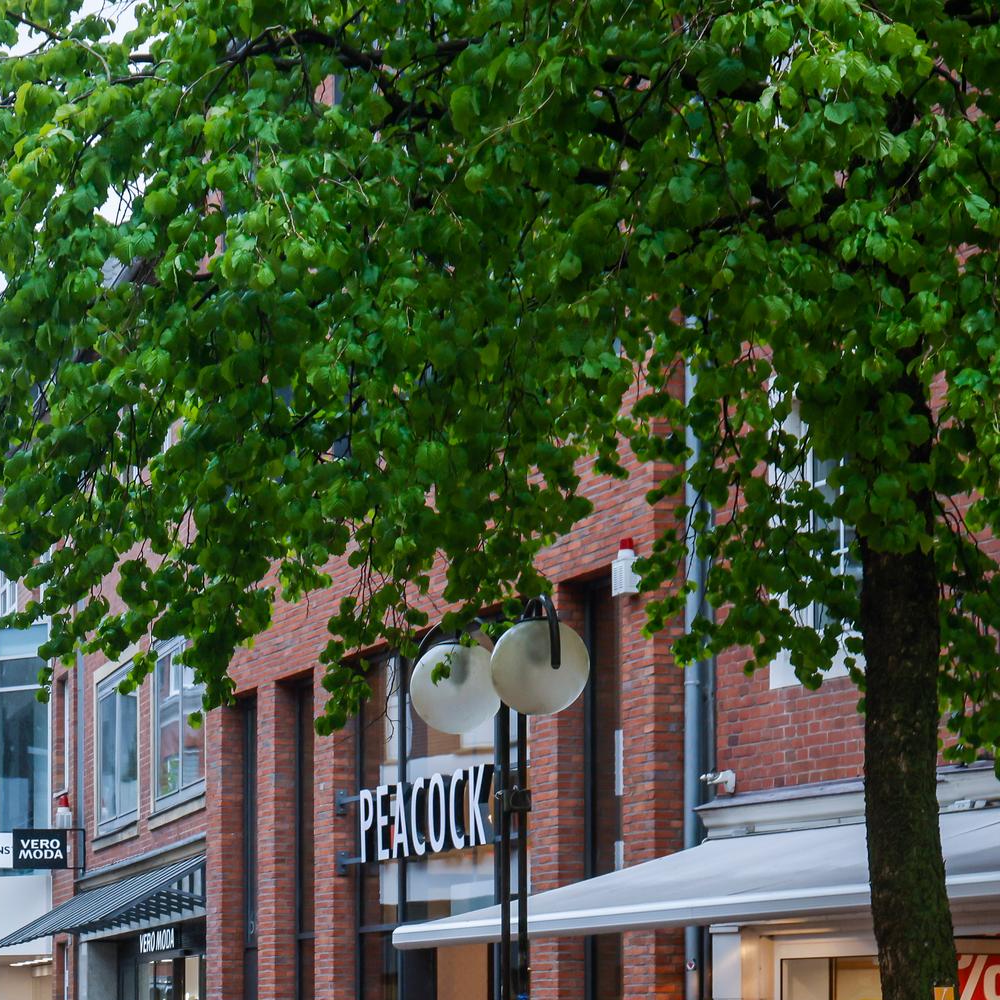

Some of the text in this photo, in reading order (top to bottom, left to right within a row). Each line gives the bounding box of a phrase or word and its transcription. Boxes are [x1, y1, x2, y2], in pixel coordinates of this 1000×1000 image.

[359, 762, 487, 863] PEACOCK
[20, 838, 61, 849] VERO
[18, 849, 64, 860] MODA
[139, 927, 175, 954] VERO MODA
